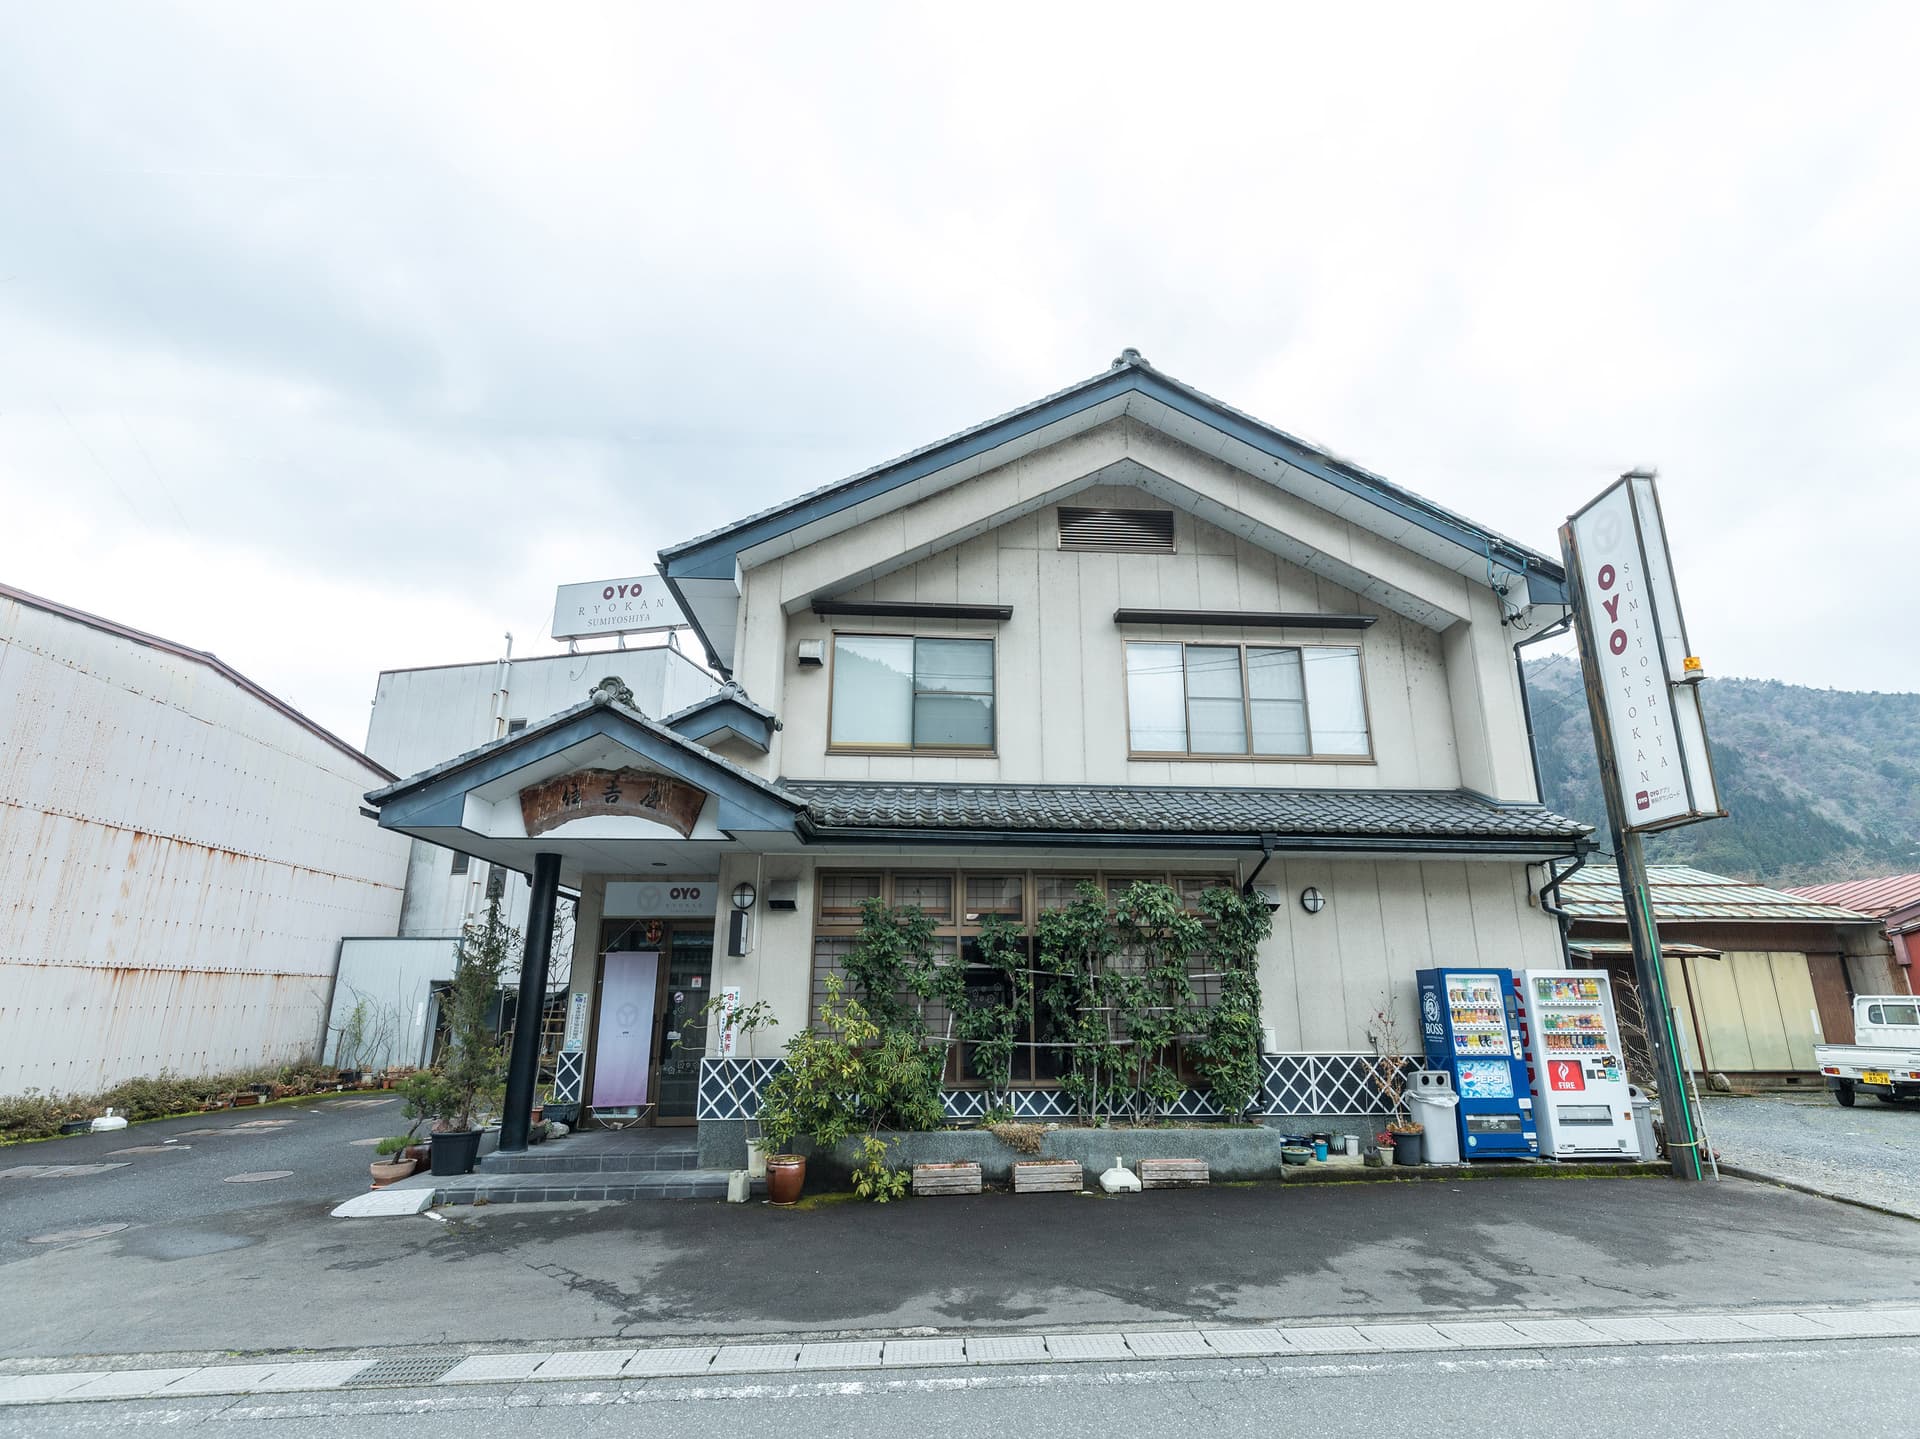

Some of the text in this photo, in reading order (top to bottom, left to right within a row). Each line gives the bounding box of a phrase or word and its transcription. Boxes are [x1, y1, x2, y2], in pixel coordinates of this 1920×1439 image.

[603, 584, 643, 600] OYO
[578, 598, 664, 616] RYOKAN
[587, 613, 651, 627] SUMIYOSHIYA
[1623, 562, 1668, 769] SUMIYOSHIYA
[1598, 564, 1650, 783] OYO RYOKAN
[669, 888, 701, 900] OYO
[1425, 1022, 1444, 1035] BOSS
[1474, 1075, 1504, 1084] PEPSI
[1557, 1081, 1576, 1089] FIRE
